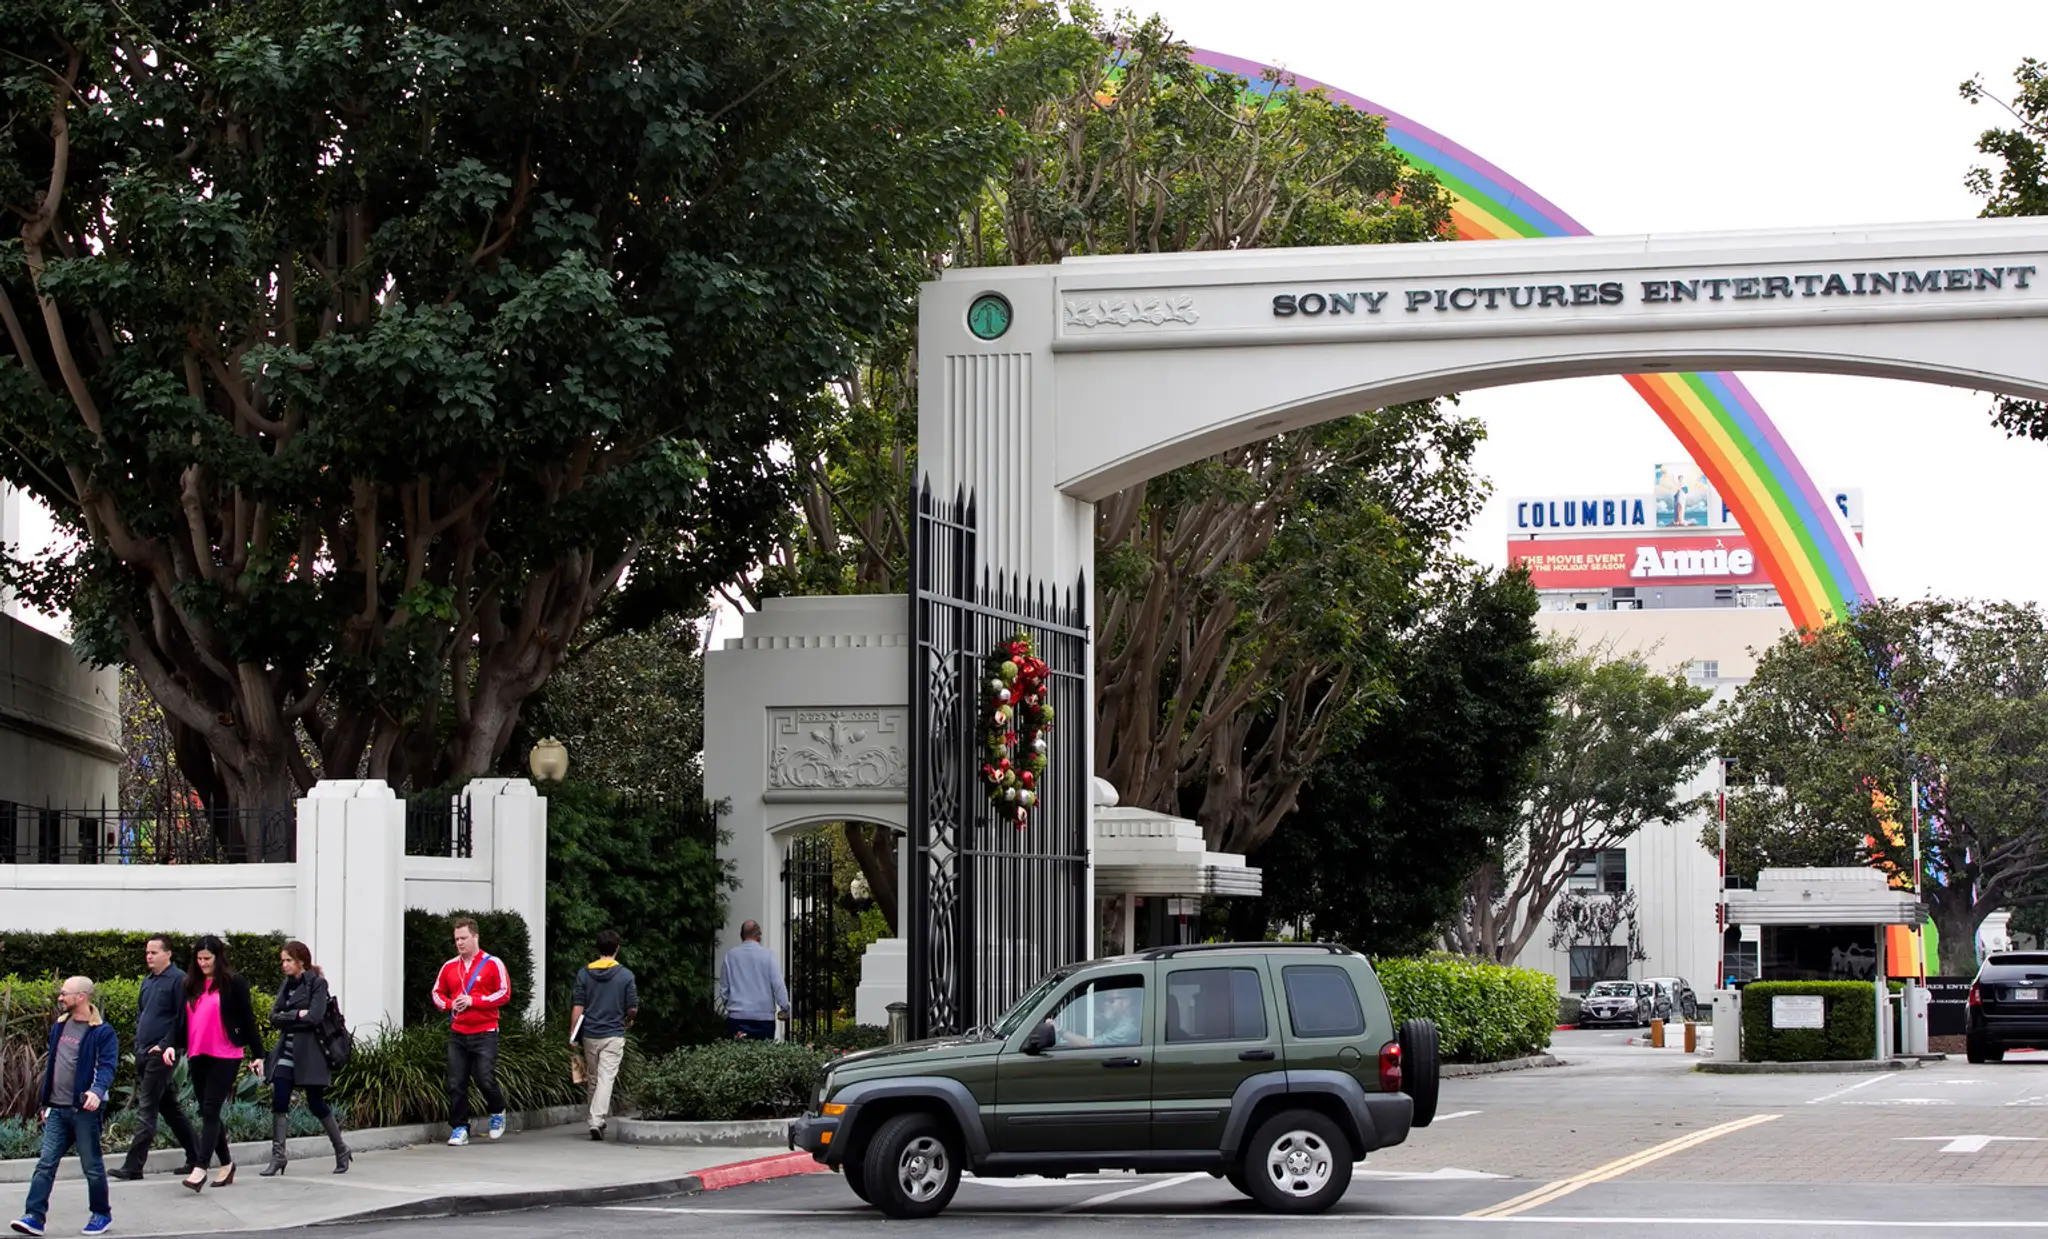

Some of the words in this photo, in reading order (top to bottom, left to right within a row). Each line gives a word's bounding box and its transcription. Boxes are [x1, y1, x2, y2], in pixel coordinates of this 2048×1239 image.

[1273, 291, 1389, 317] SONY
[1404, 282, 1624, 312] PICTURES
[1641, 265, 2036, 302] ENTERTAINMENT
[1518, 499, 1646, 528] COLUMBIA
[1520, 555, 1543, 564] THE
[1546, 554, 1583, 564] MOVIE
[1587, 553, 1625, 563] EVENT
[1535, 564, 1551, 572] THE
[1553, 563, 1589, 571] HOLIDAY
[1591, 562, 1625, 571] SEASON
[1630, 544, 1754, 577] Annie
